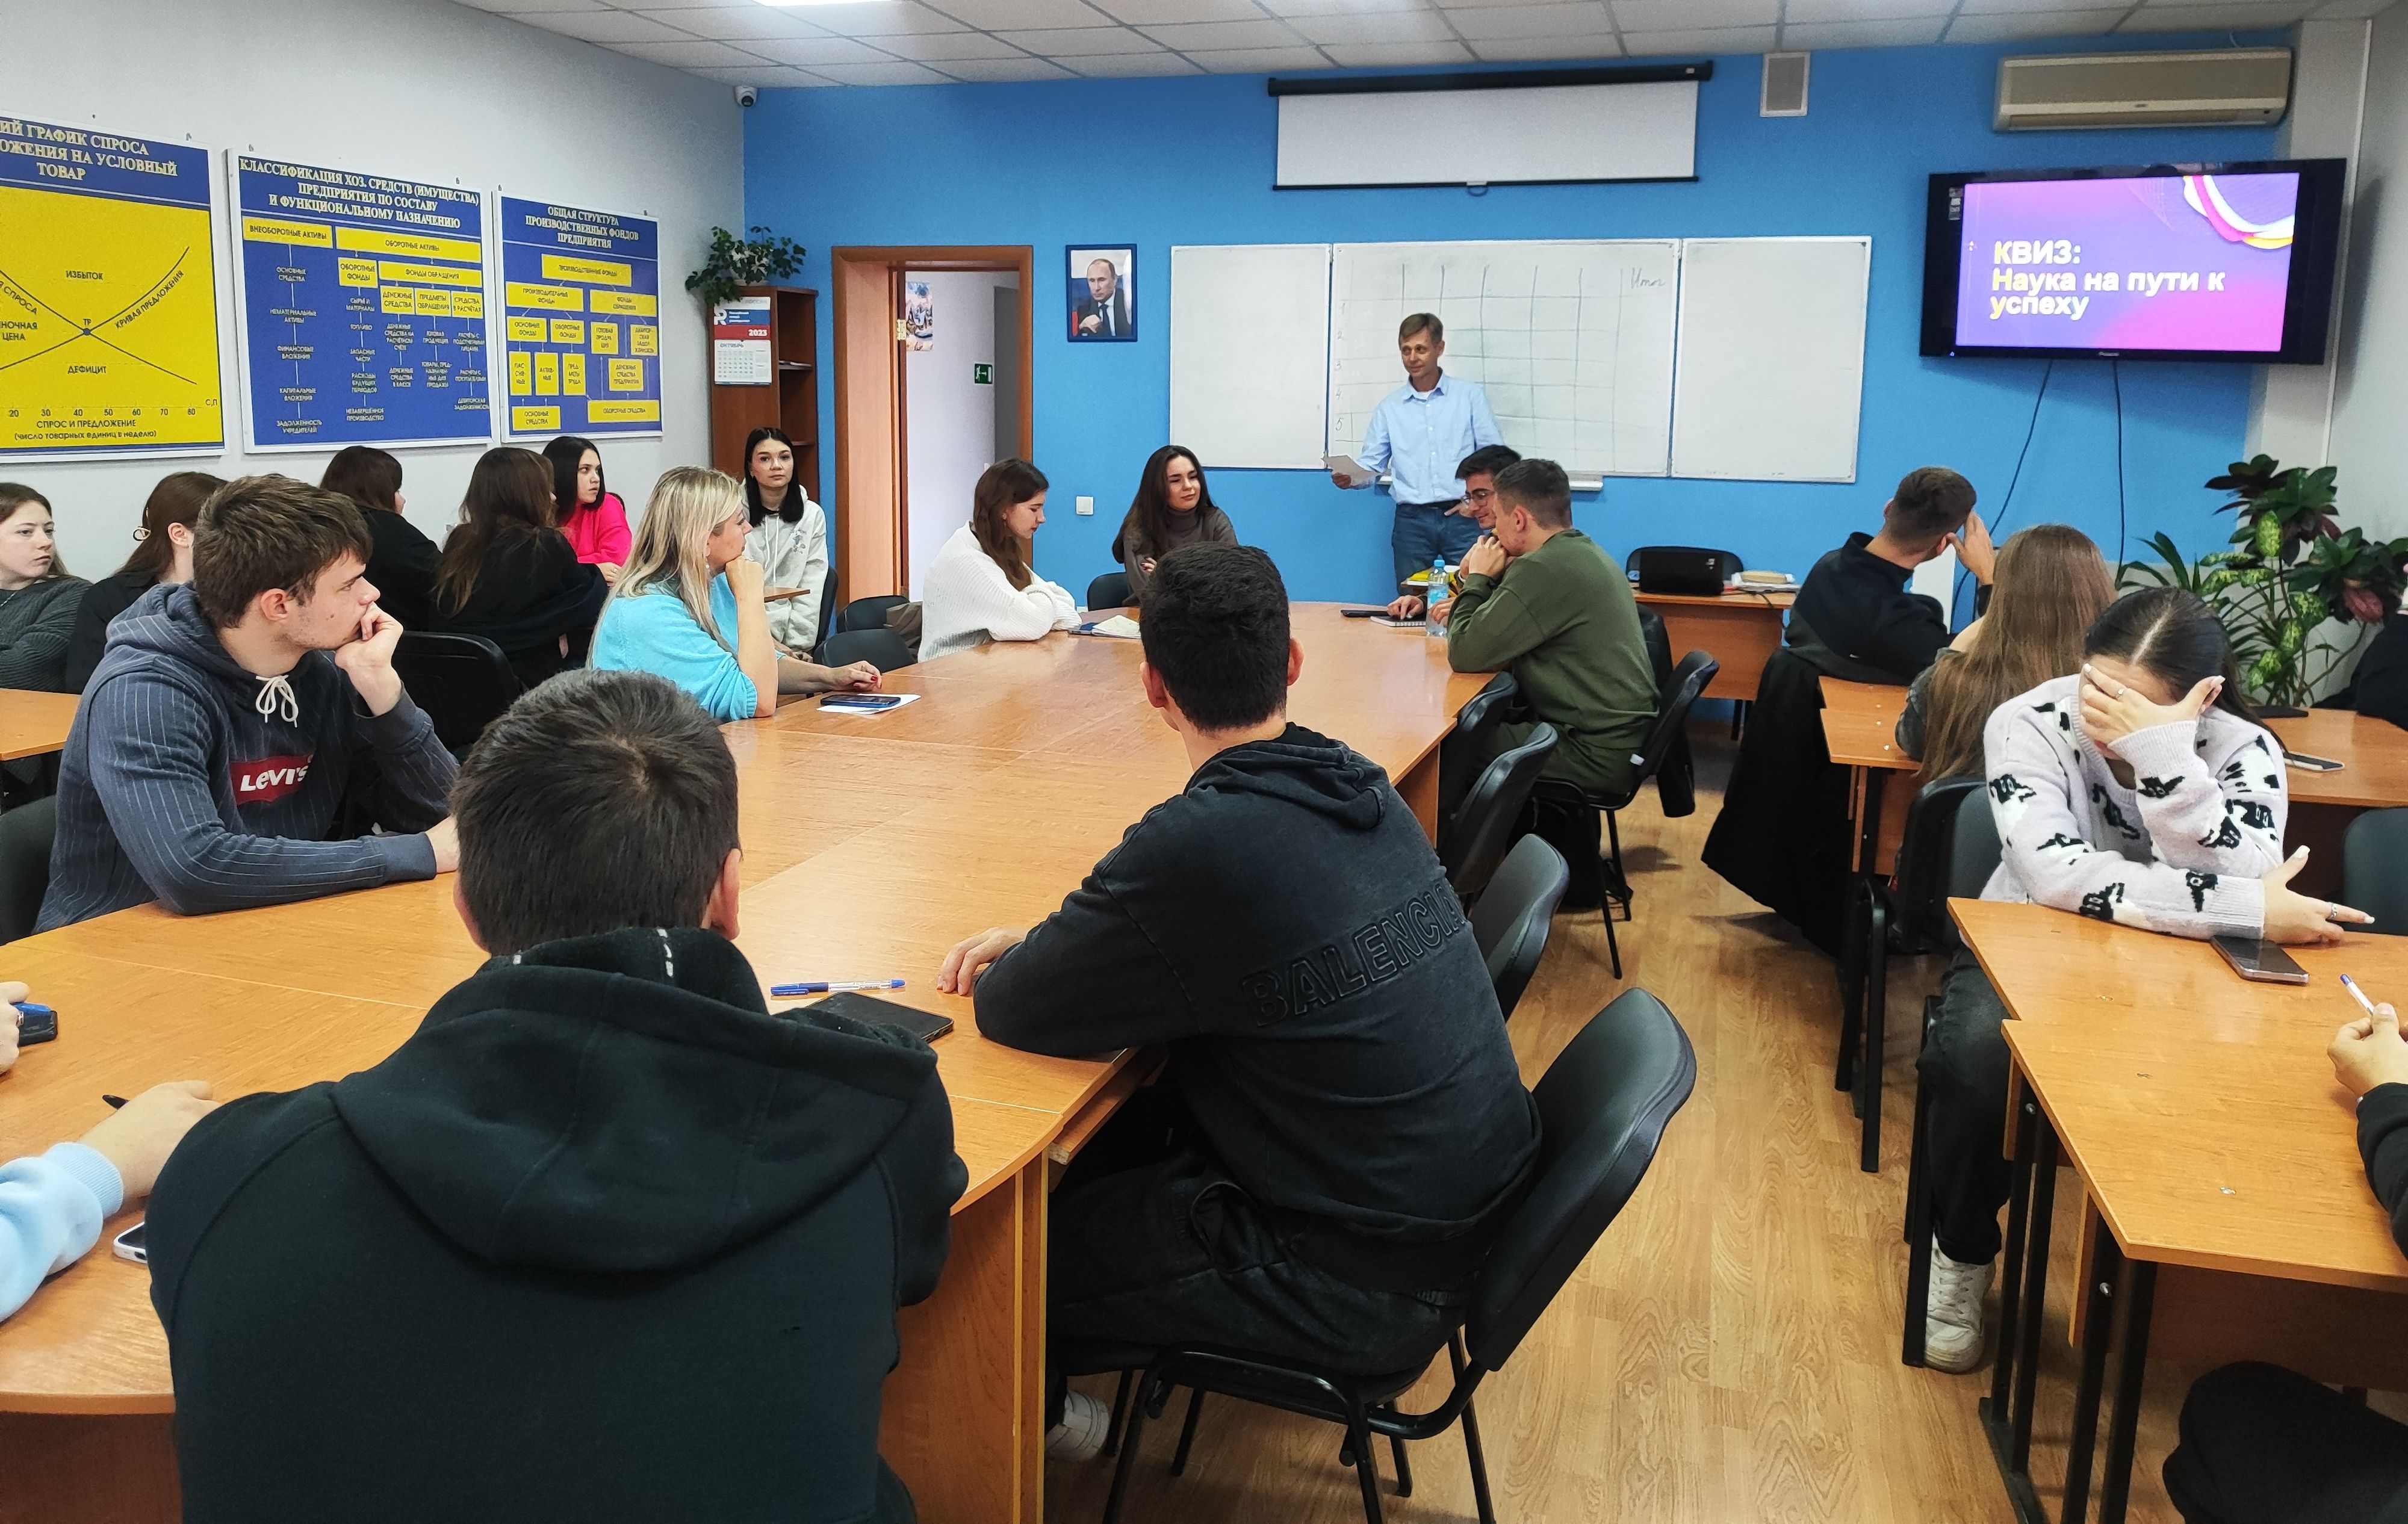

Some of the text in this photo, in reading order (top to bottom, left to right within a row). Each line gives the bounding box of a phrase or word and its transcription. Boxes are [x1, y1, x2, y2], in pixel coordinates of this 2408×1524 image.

[0, 120, 149, 155] ИЙ ГРАФИК СПРОСА
[36, 162, 86, 181] ТОВАР
[70, 149, 93, 164] НА
[95, 153, 178, 176] УСЛОВНЫЙ
[239, 158, 479, 206] КЛАССИФИКАЦИЯ ХОЗ. СРЕДСТВ (ИМУЩЕСТВА)
[297, 182, 438, 212] ПРЕДПРИЯТИЯ ПО СОСТАВУ
[268, 194, 461, 229] И ФУНКЦИОНАЛЬНОМУ НАЗНАЧЕНИЮ
[547, 206, 620, 226] ОБЩАЯ СТРУКТУРА
[250, 225, 327, 240] ВНЕОБОРОТНЫЕ АКТИВЫ
[525, 215, 640, 241] ПРОИЗВОДСТВЕННЫХ ФОНДОВ
[557, 232, 612, 249] ПРЕДПРИЯТИЯ
[1994, 240, 2081, 264] КВИЗ:
[66, 270, 103, 280] ИЗБЫТОК
[340, 263, 376, 272] ОБОРОТНЫЕ
[1992, 267, 2226, 297] Наука на пути к
[4, 286, 37, 315] СПРОСА
[114, 270, 184, 329] КРИВАЯ ПРЕДЛОЖЕНИЯ
[1990, 295, 2090, 321] успеху
[0, 321, 38, 330] НОЧНАЯ
[2, 332, 25, 341] ЦЕНА
[67, 365, 107, 374] ДЕФИЦИТ
[37, 420, 67, 429] СПРОС
[77, 420, 137, 428] ПРЕДЛОЖЕНИЕ
